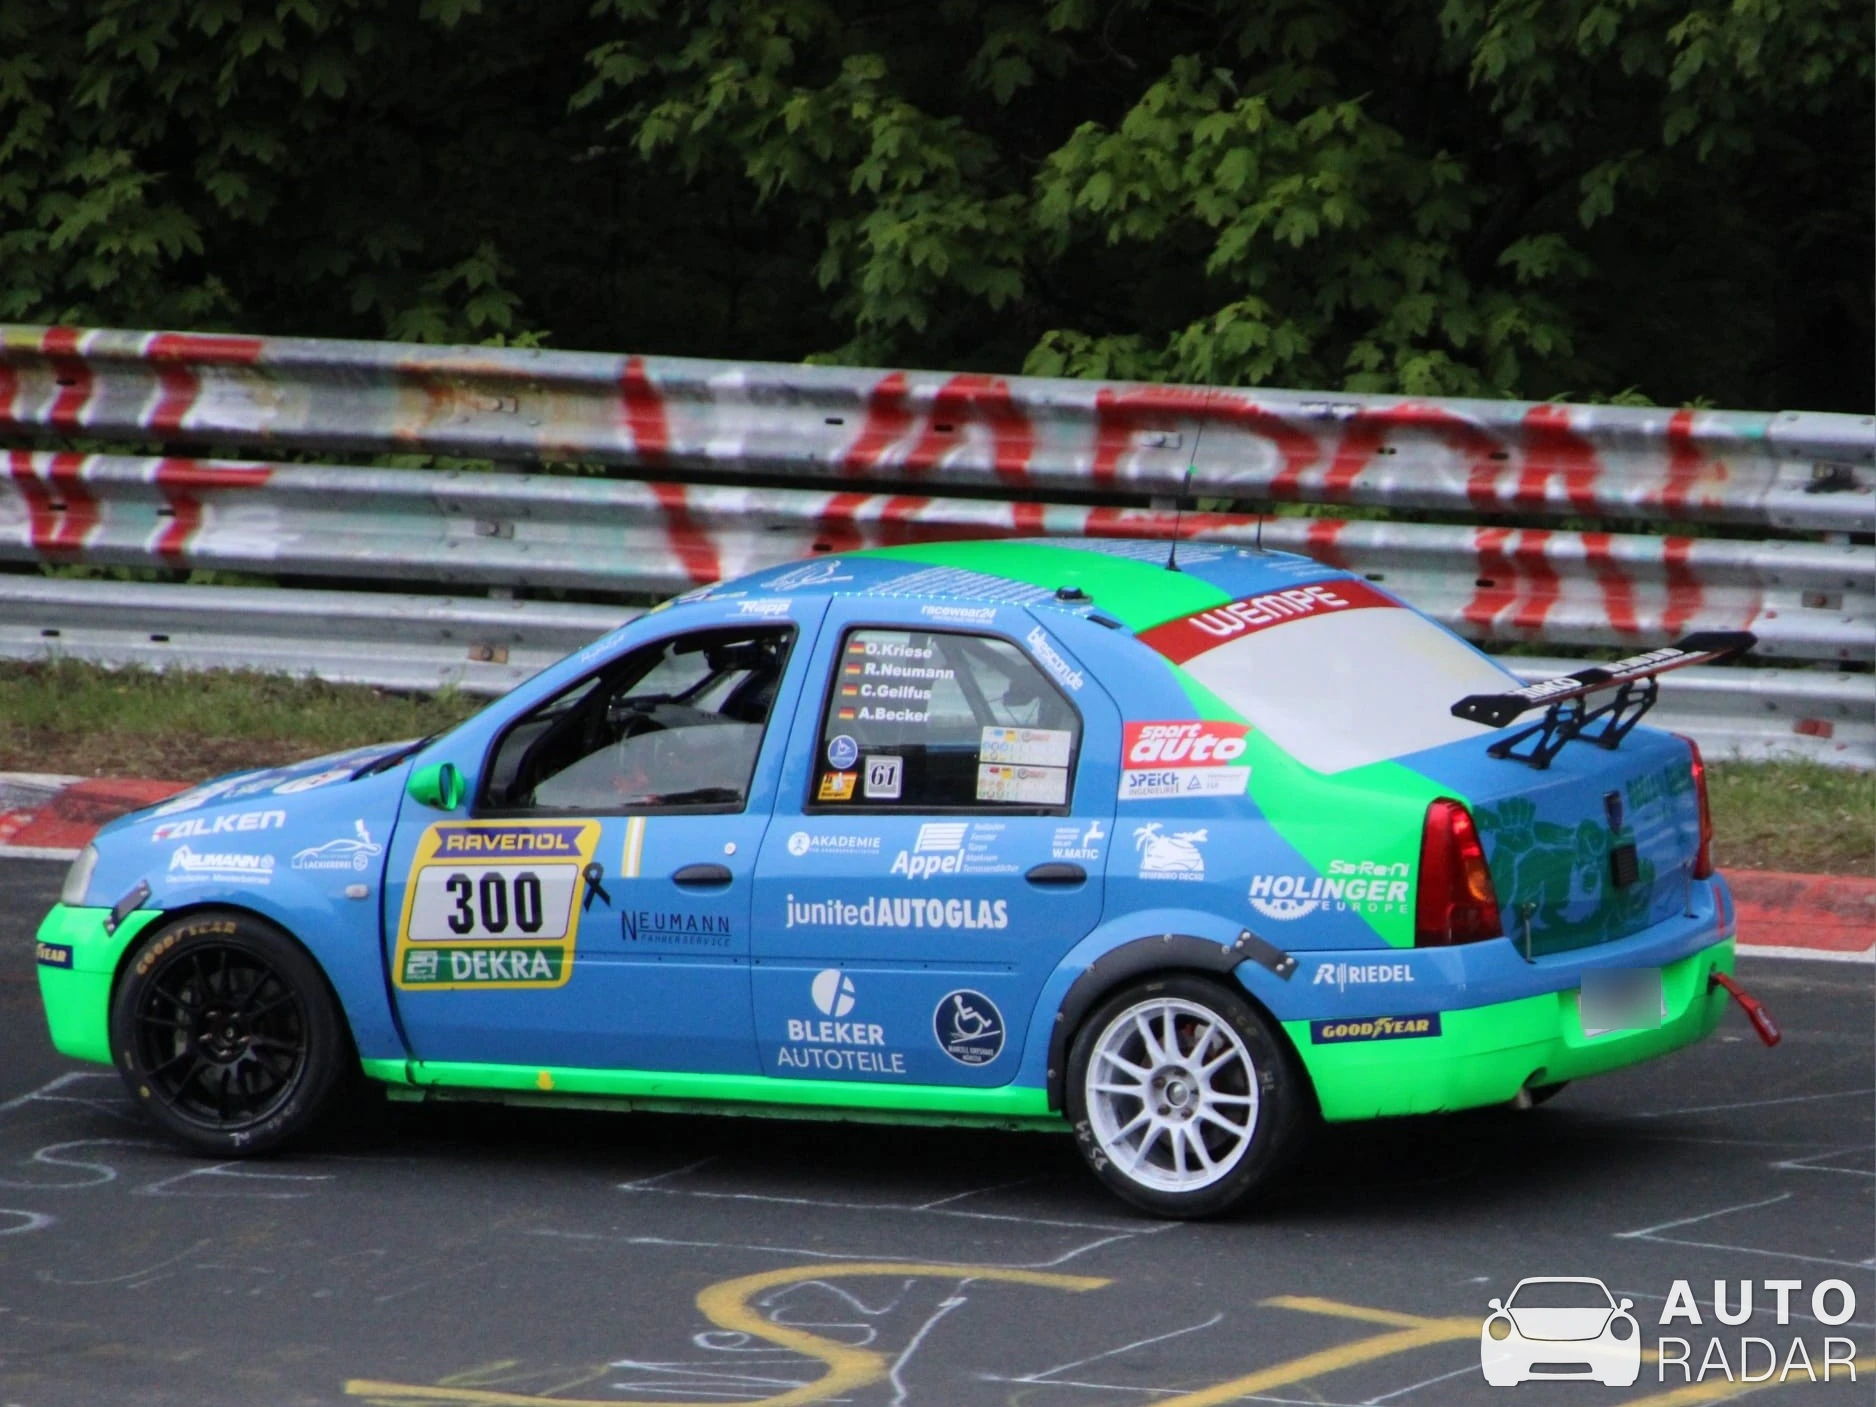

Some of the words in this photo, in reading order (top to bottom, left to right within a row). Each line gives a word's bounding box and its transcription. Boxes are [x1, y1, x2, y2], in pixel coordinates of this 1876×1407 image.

[1188, 586, 1349, 636] WEMPE
[864, 662, 955, 679] R.Neumann
[861, 683, 932, 700] C.Geilfus
[858, 707, 931, 722] A.Becker
[1139, 723, 1202, 741] sport
[1130, 734, 1247, 763] auto
[871, 765, 896, 786] 61
[151, 810, 286, 842] FALKEN
[446, 833, 570, 851] RAVENOL
[811, 836, 881, 849] AKADEMIE
[890, 849, 965, 879] Appel
[1249, 875, 1409, 903] HOLINGER
[446, 871, 543, 935] 300
[1321, 901, 1409, 914] EUROPE
[621, 909, 731, 942] NEUMANN
[451, 949, 553, 980] DEKRA
[1348, 964, 1415, 984] RIEDEL
[788, 1019, 885, 1046] BLEKER
[1322, 1017, 1430, 1039] GOODYEAR
[777, 1047, 906, 1074] AUTOTEILE
